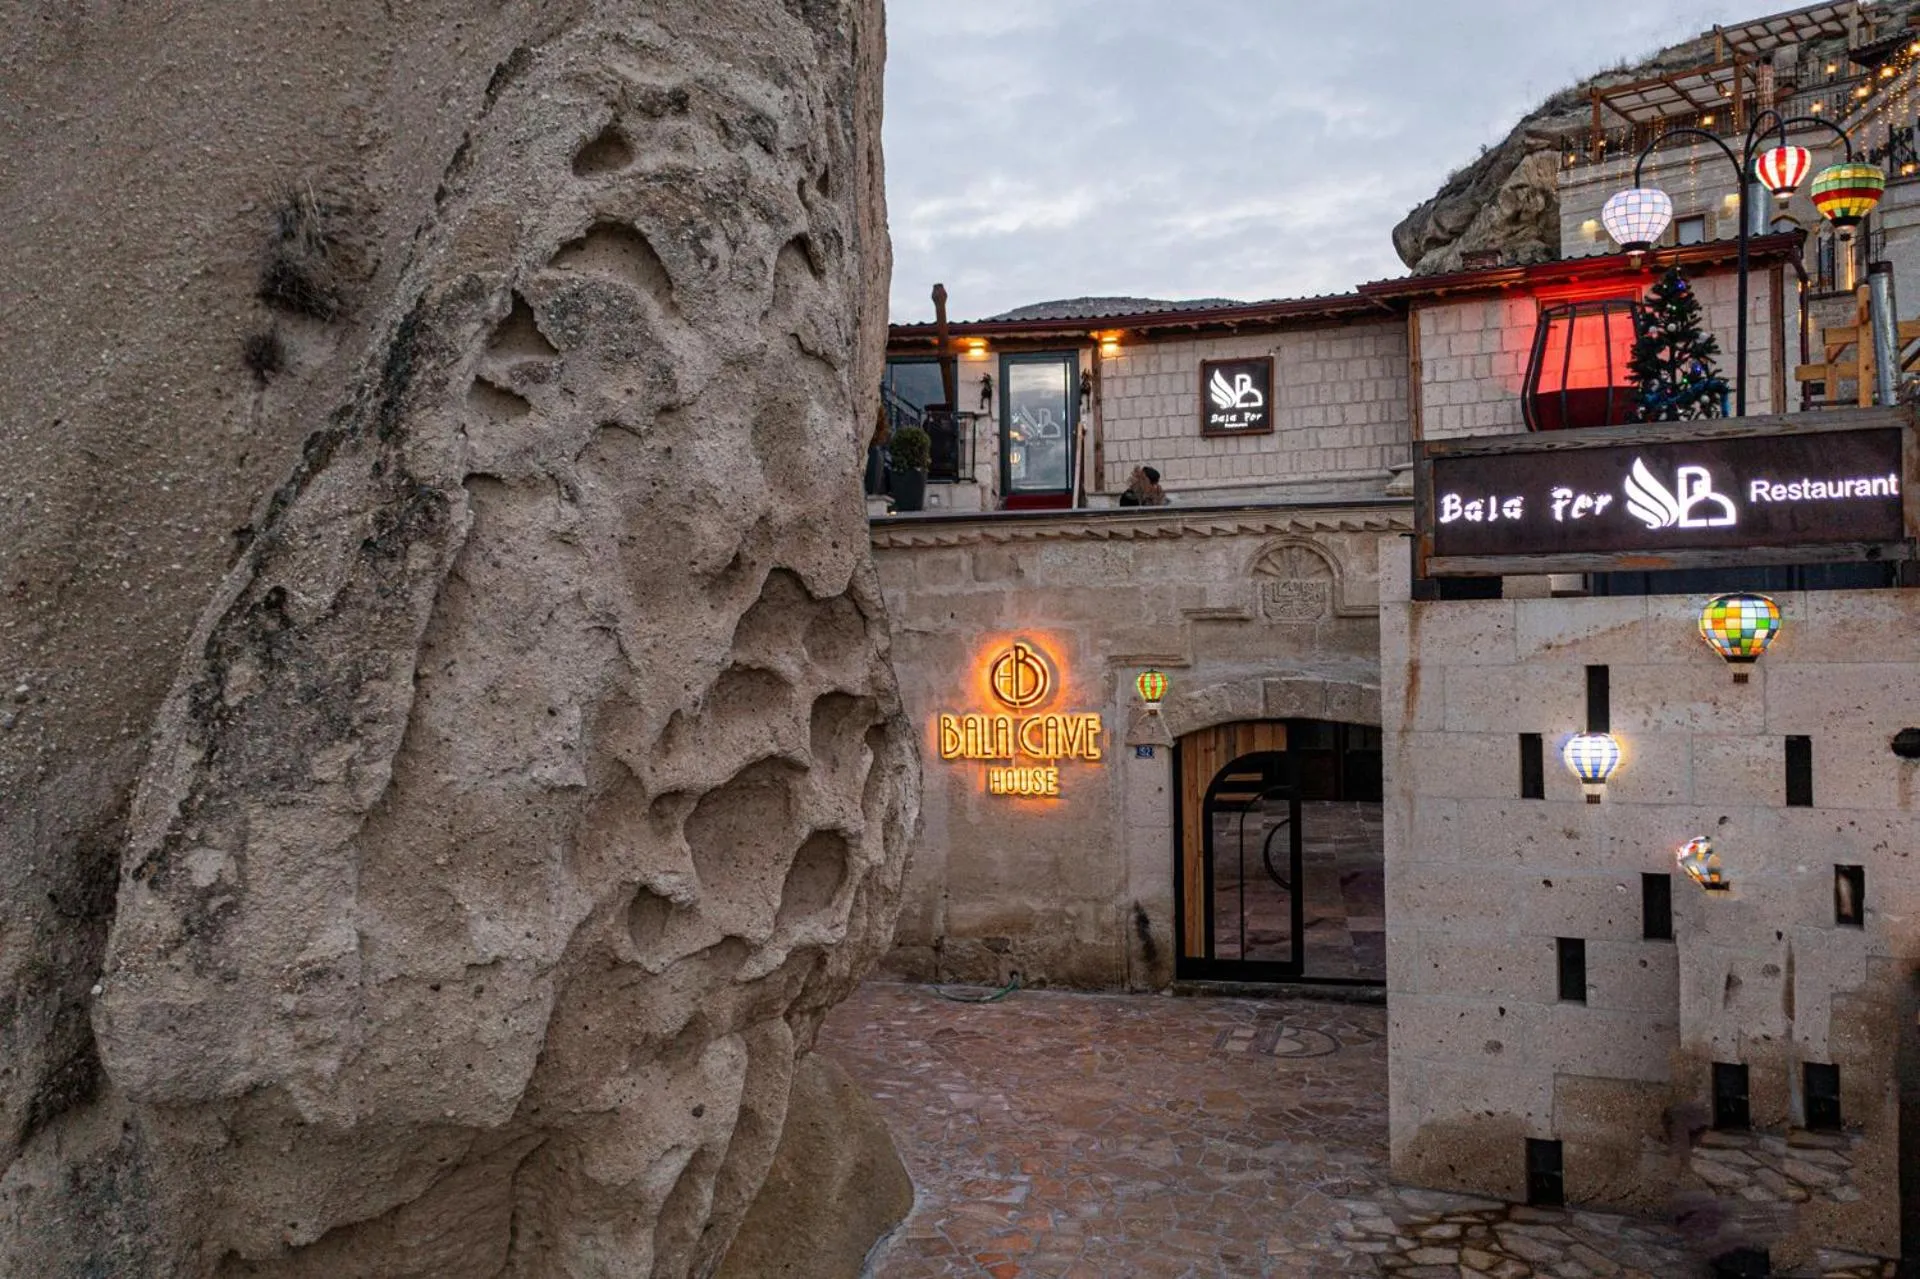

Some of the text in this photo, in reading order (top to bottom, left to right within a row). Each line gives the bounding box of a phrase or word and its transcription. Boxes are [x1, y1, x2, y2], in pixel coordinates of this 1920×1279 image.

[1439, 493, 1525, 524] Bala
[1551, 486, 1613, 522] Per
[1750, 473, 1900, 503] Restaurant
[940, 714, 1101, 759] BALA CAVE
[990, 767, 1058, 795] HOUSE
